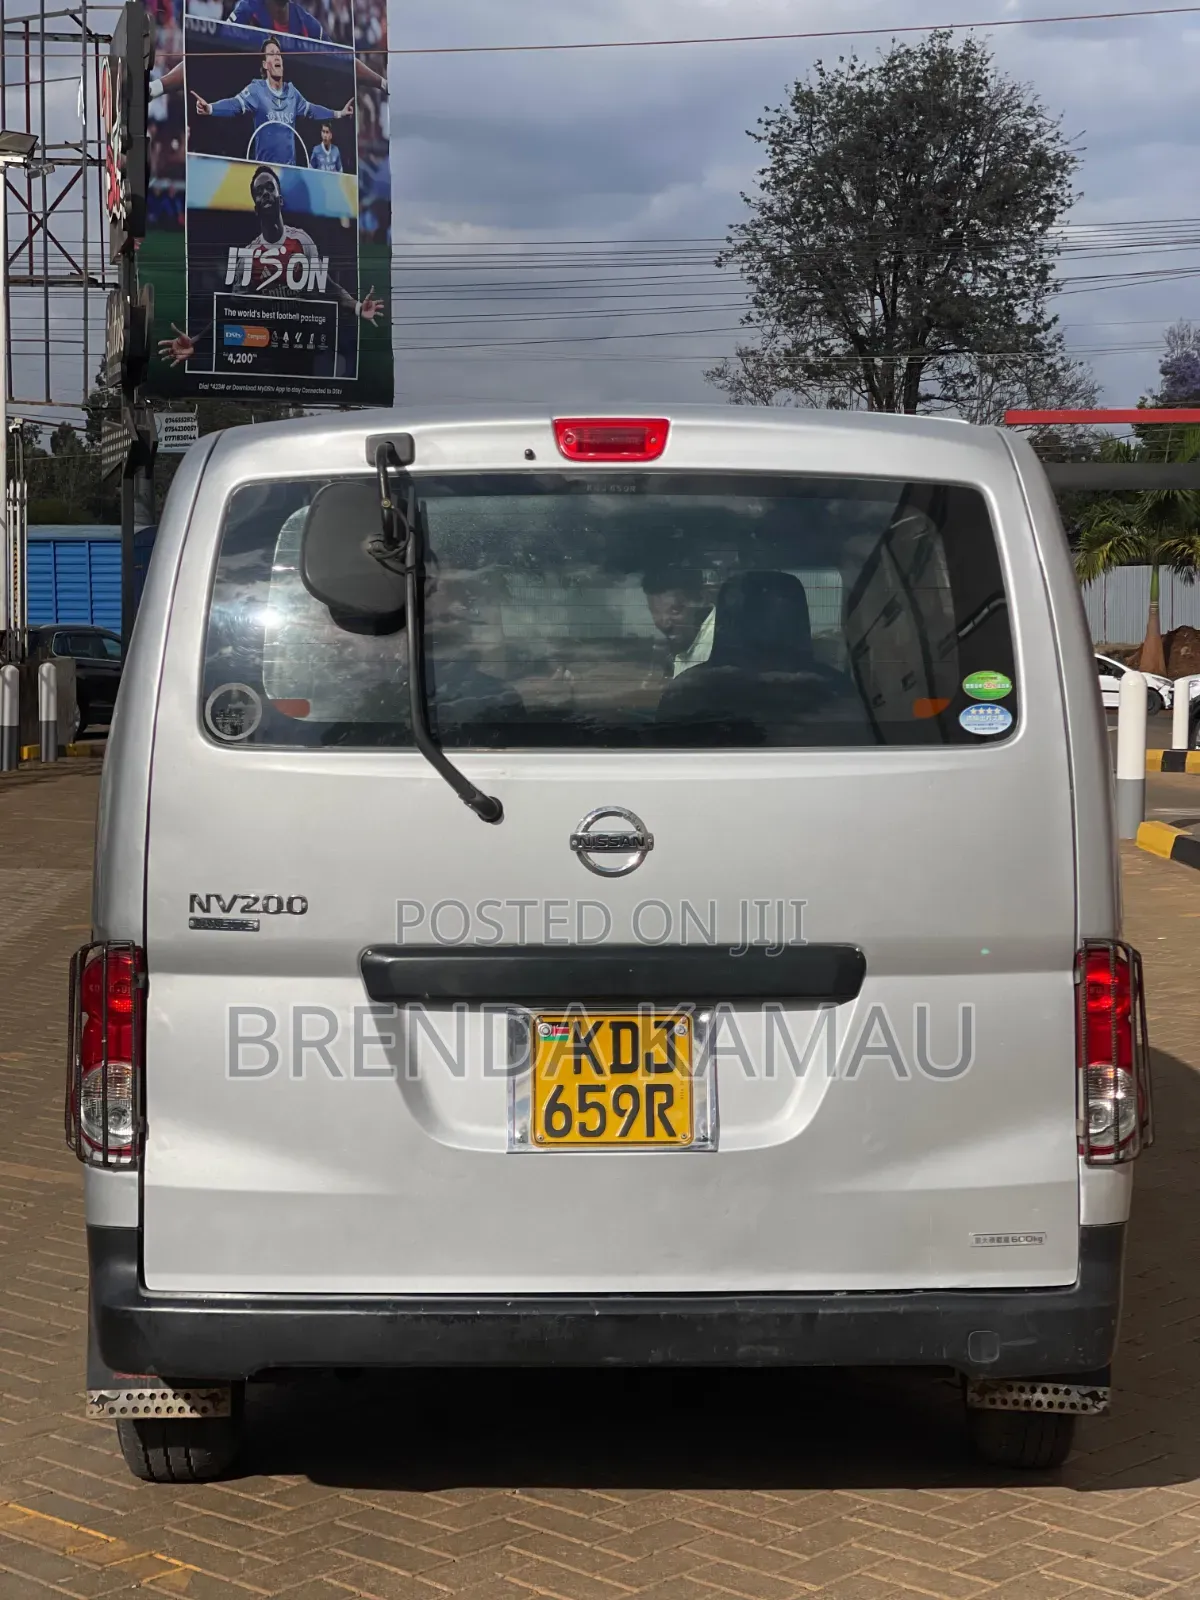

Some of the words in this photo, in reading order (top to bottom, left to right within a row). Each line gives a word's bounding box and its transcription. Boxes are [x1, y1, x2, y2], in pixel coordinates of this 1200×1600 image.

[225, 246, 287, 291] IT'S
[286, 252, 330, 293] ON
[224, 307, 236, 316] The
[237, 308, 260, 318] world's
[262, 310, 275, 319] best
[276, 310, 300, 321] football
[300, 313, 326, 325] package
[227, 353, 253, 364] 4,200
[198, 382, 209, 390] Dial
[275, 386, 285, 394] App
[578, 836, 645, 848] NISSAN
[188, 892, 309, 916] NV200
[573, 1020, 676, 1075] KDJ
[544, 1083, 678, 1138] 659R
